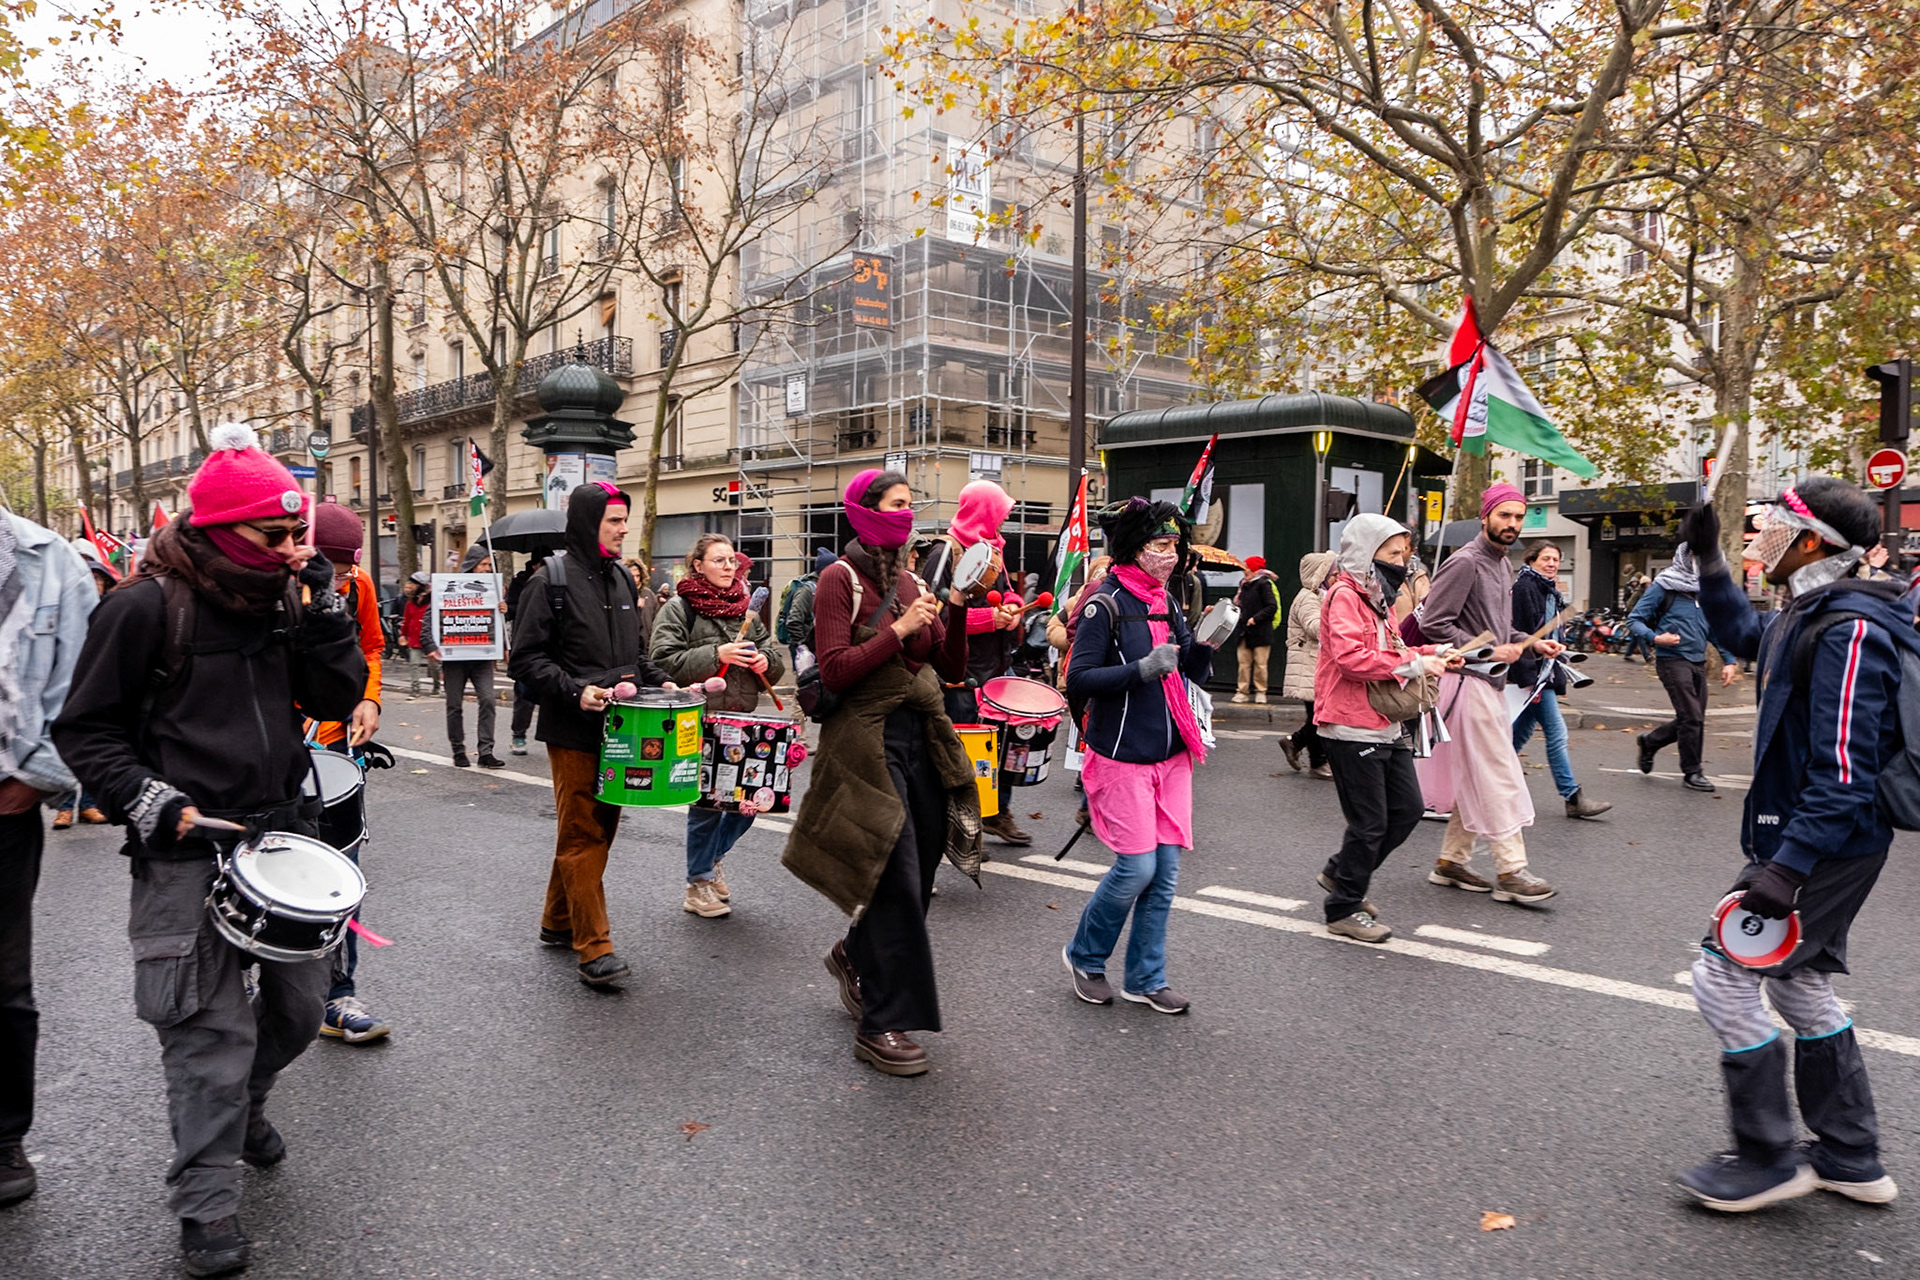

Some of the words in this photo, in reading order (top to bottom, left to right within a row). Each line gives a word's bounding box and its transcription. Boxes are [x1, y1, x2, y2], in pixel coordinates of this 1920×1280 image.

[310, 435, 329, 446] BUS
[712, 487, 728, 503] SG
[443, 597, 485, 608] PALESTINE
[443, 615, 454, 624] du
[455, 615, 492, 624] territoire
[443, 624, 489, 635] palestinien
[443, 635, 460, 645] PAR
